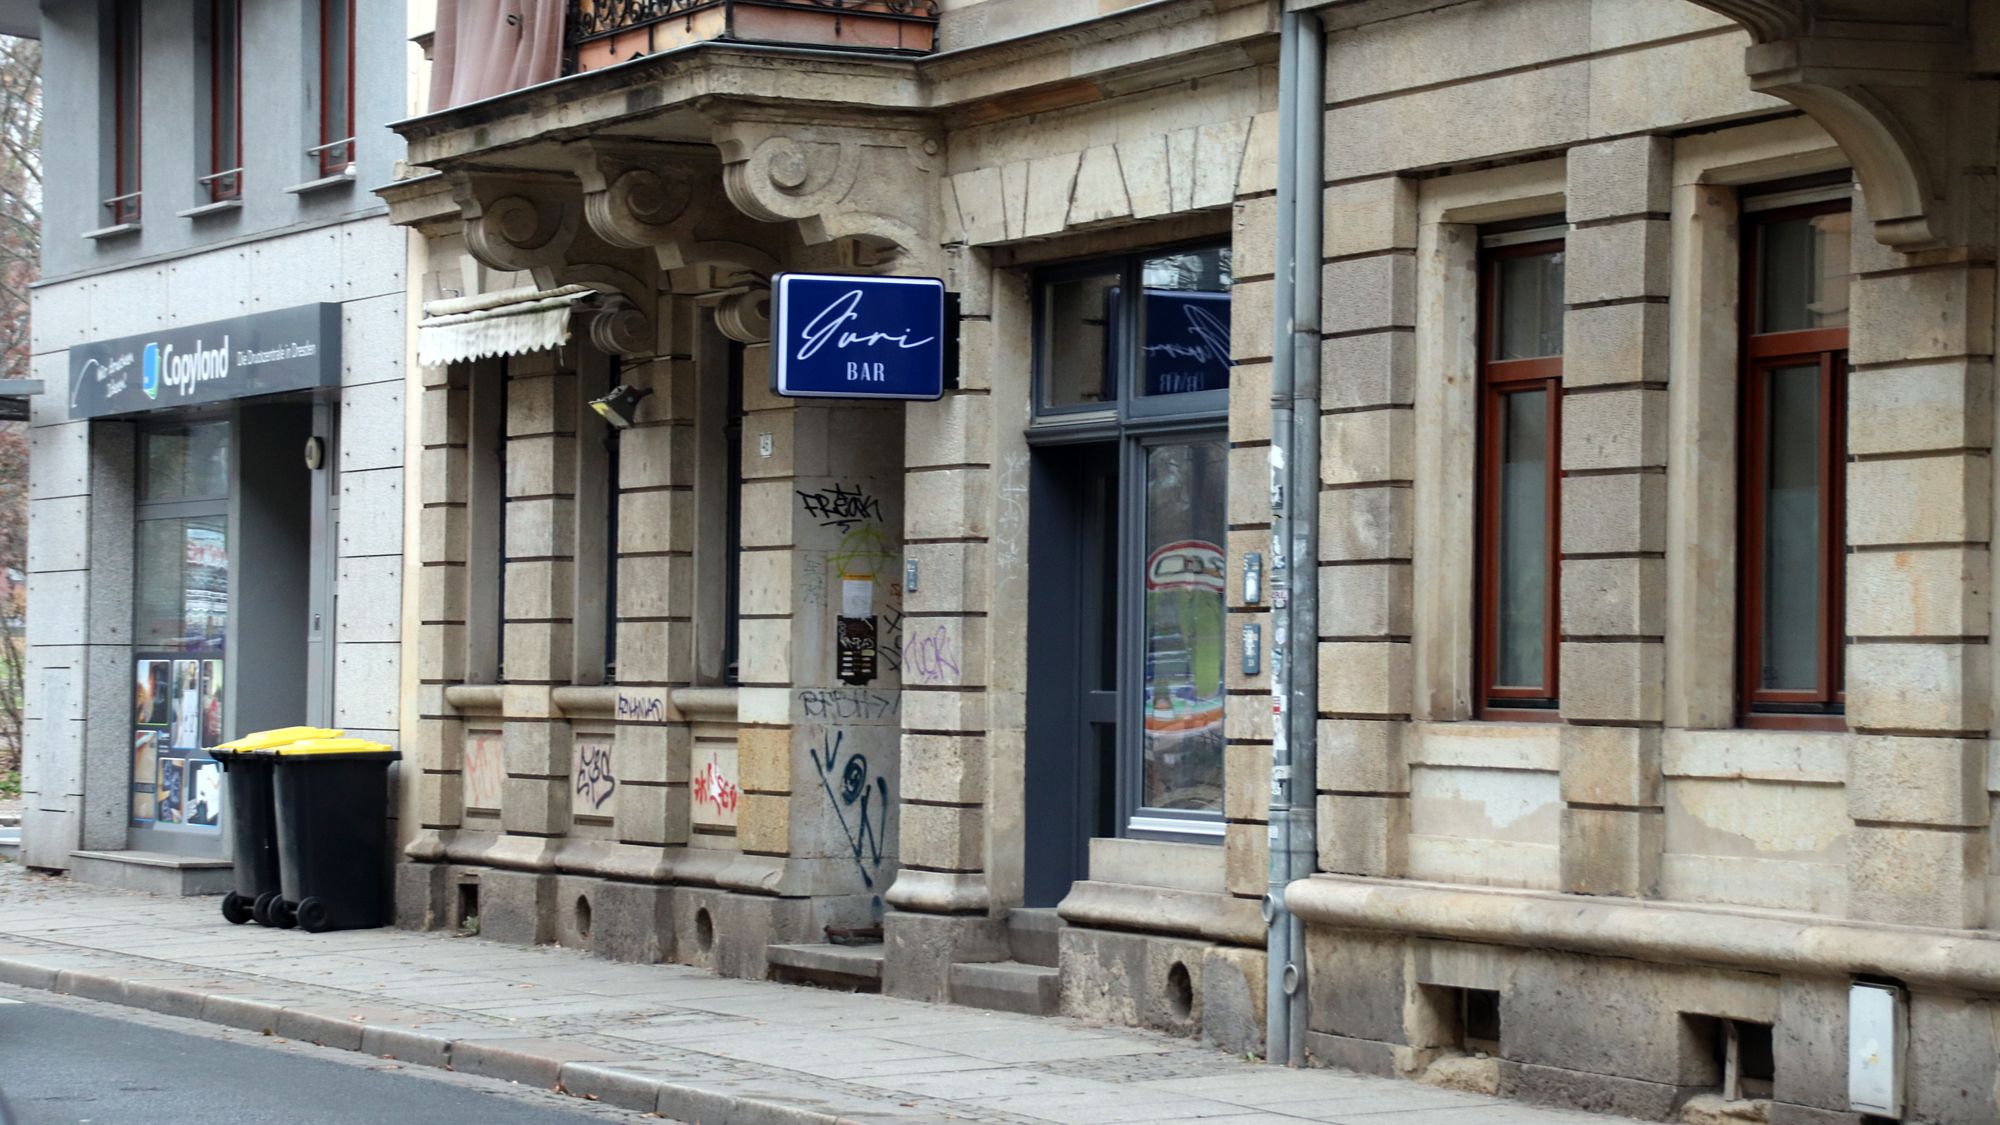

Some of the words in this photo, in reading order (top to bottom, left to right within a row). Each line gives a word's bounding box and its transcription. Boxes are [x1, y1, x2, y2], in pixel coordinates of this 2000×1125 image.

[292, 340, 317, 358] Dresden
[163, 335, 229, 396] Copyland
[847, 361, 885, 382] BAR
